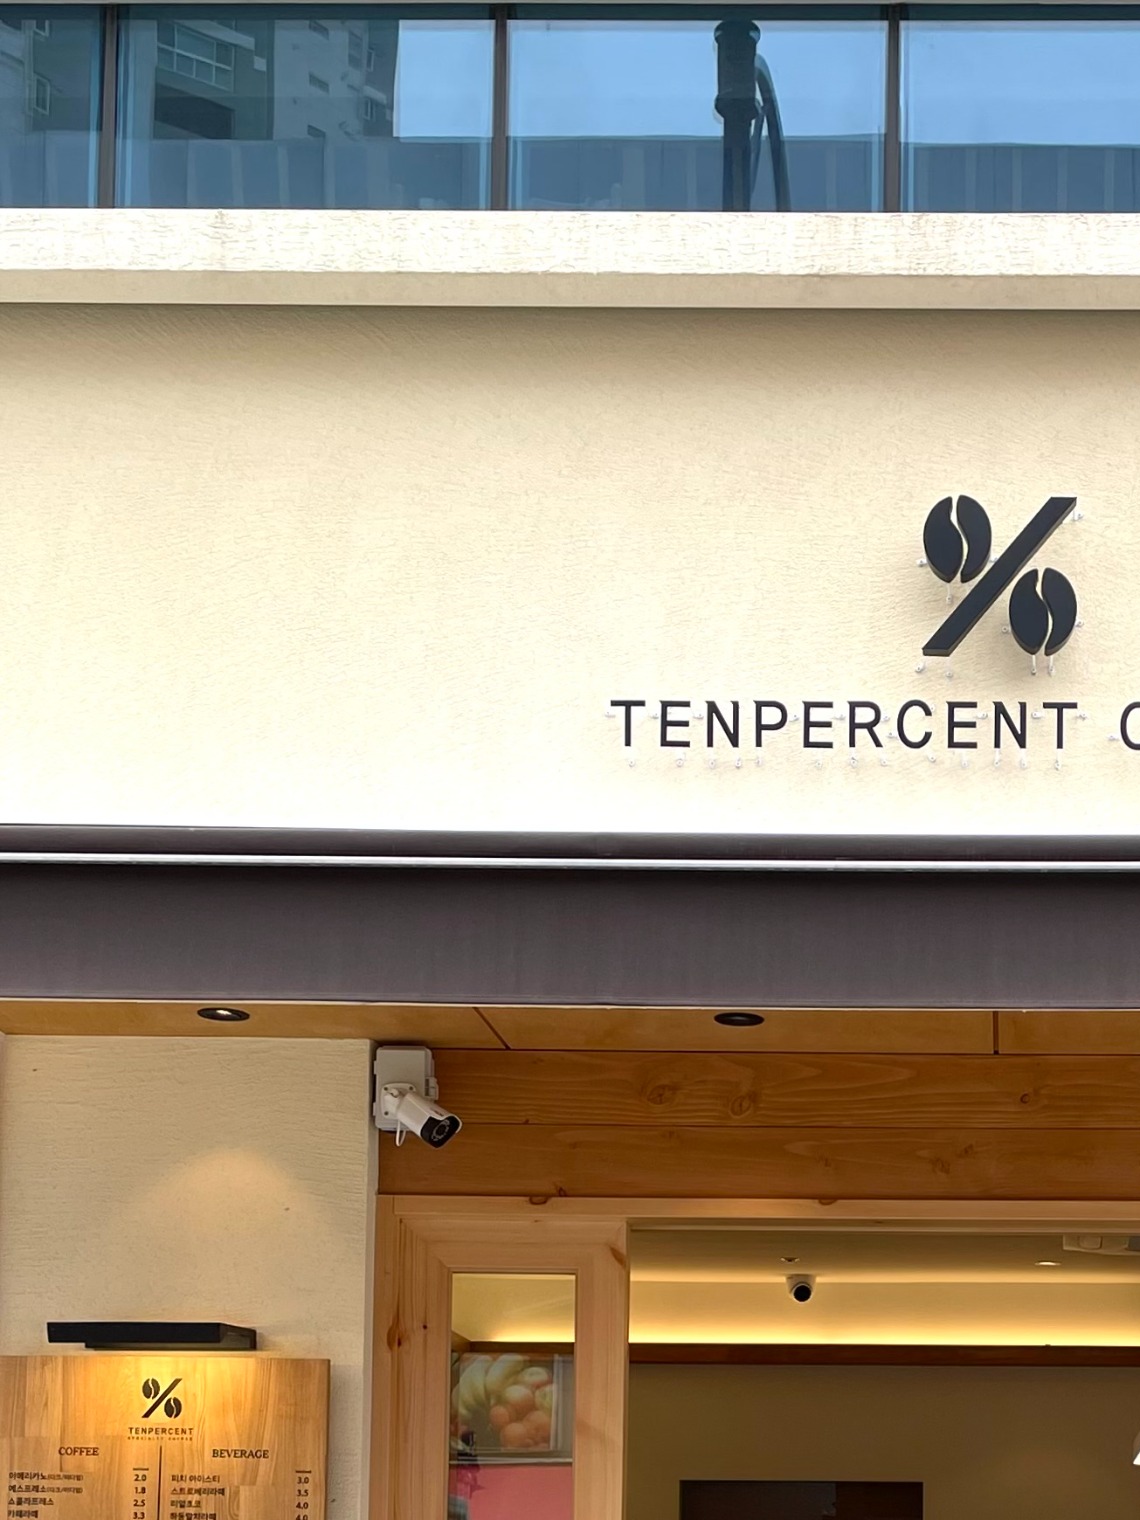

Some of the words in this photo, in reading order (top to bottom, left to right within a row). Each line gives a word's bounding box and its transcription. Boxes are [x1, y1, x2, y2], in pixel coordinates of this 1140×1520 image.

[610, 700, 1078, 750] TENPERCENT
[128, 1427, 194, 1436] TENPERCENT
[58, 1446, 100, 1456] COFFEE
[212, 1448, 270, 1459] BEVERAGE
[189, 1475, 220, 1483] 아이스티
[135, 1486, 146, 1494] 1.8
[133, 1499, 146, 1507] 2.5
[133, 1512, 145, 1520] 3.3
